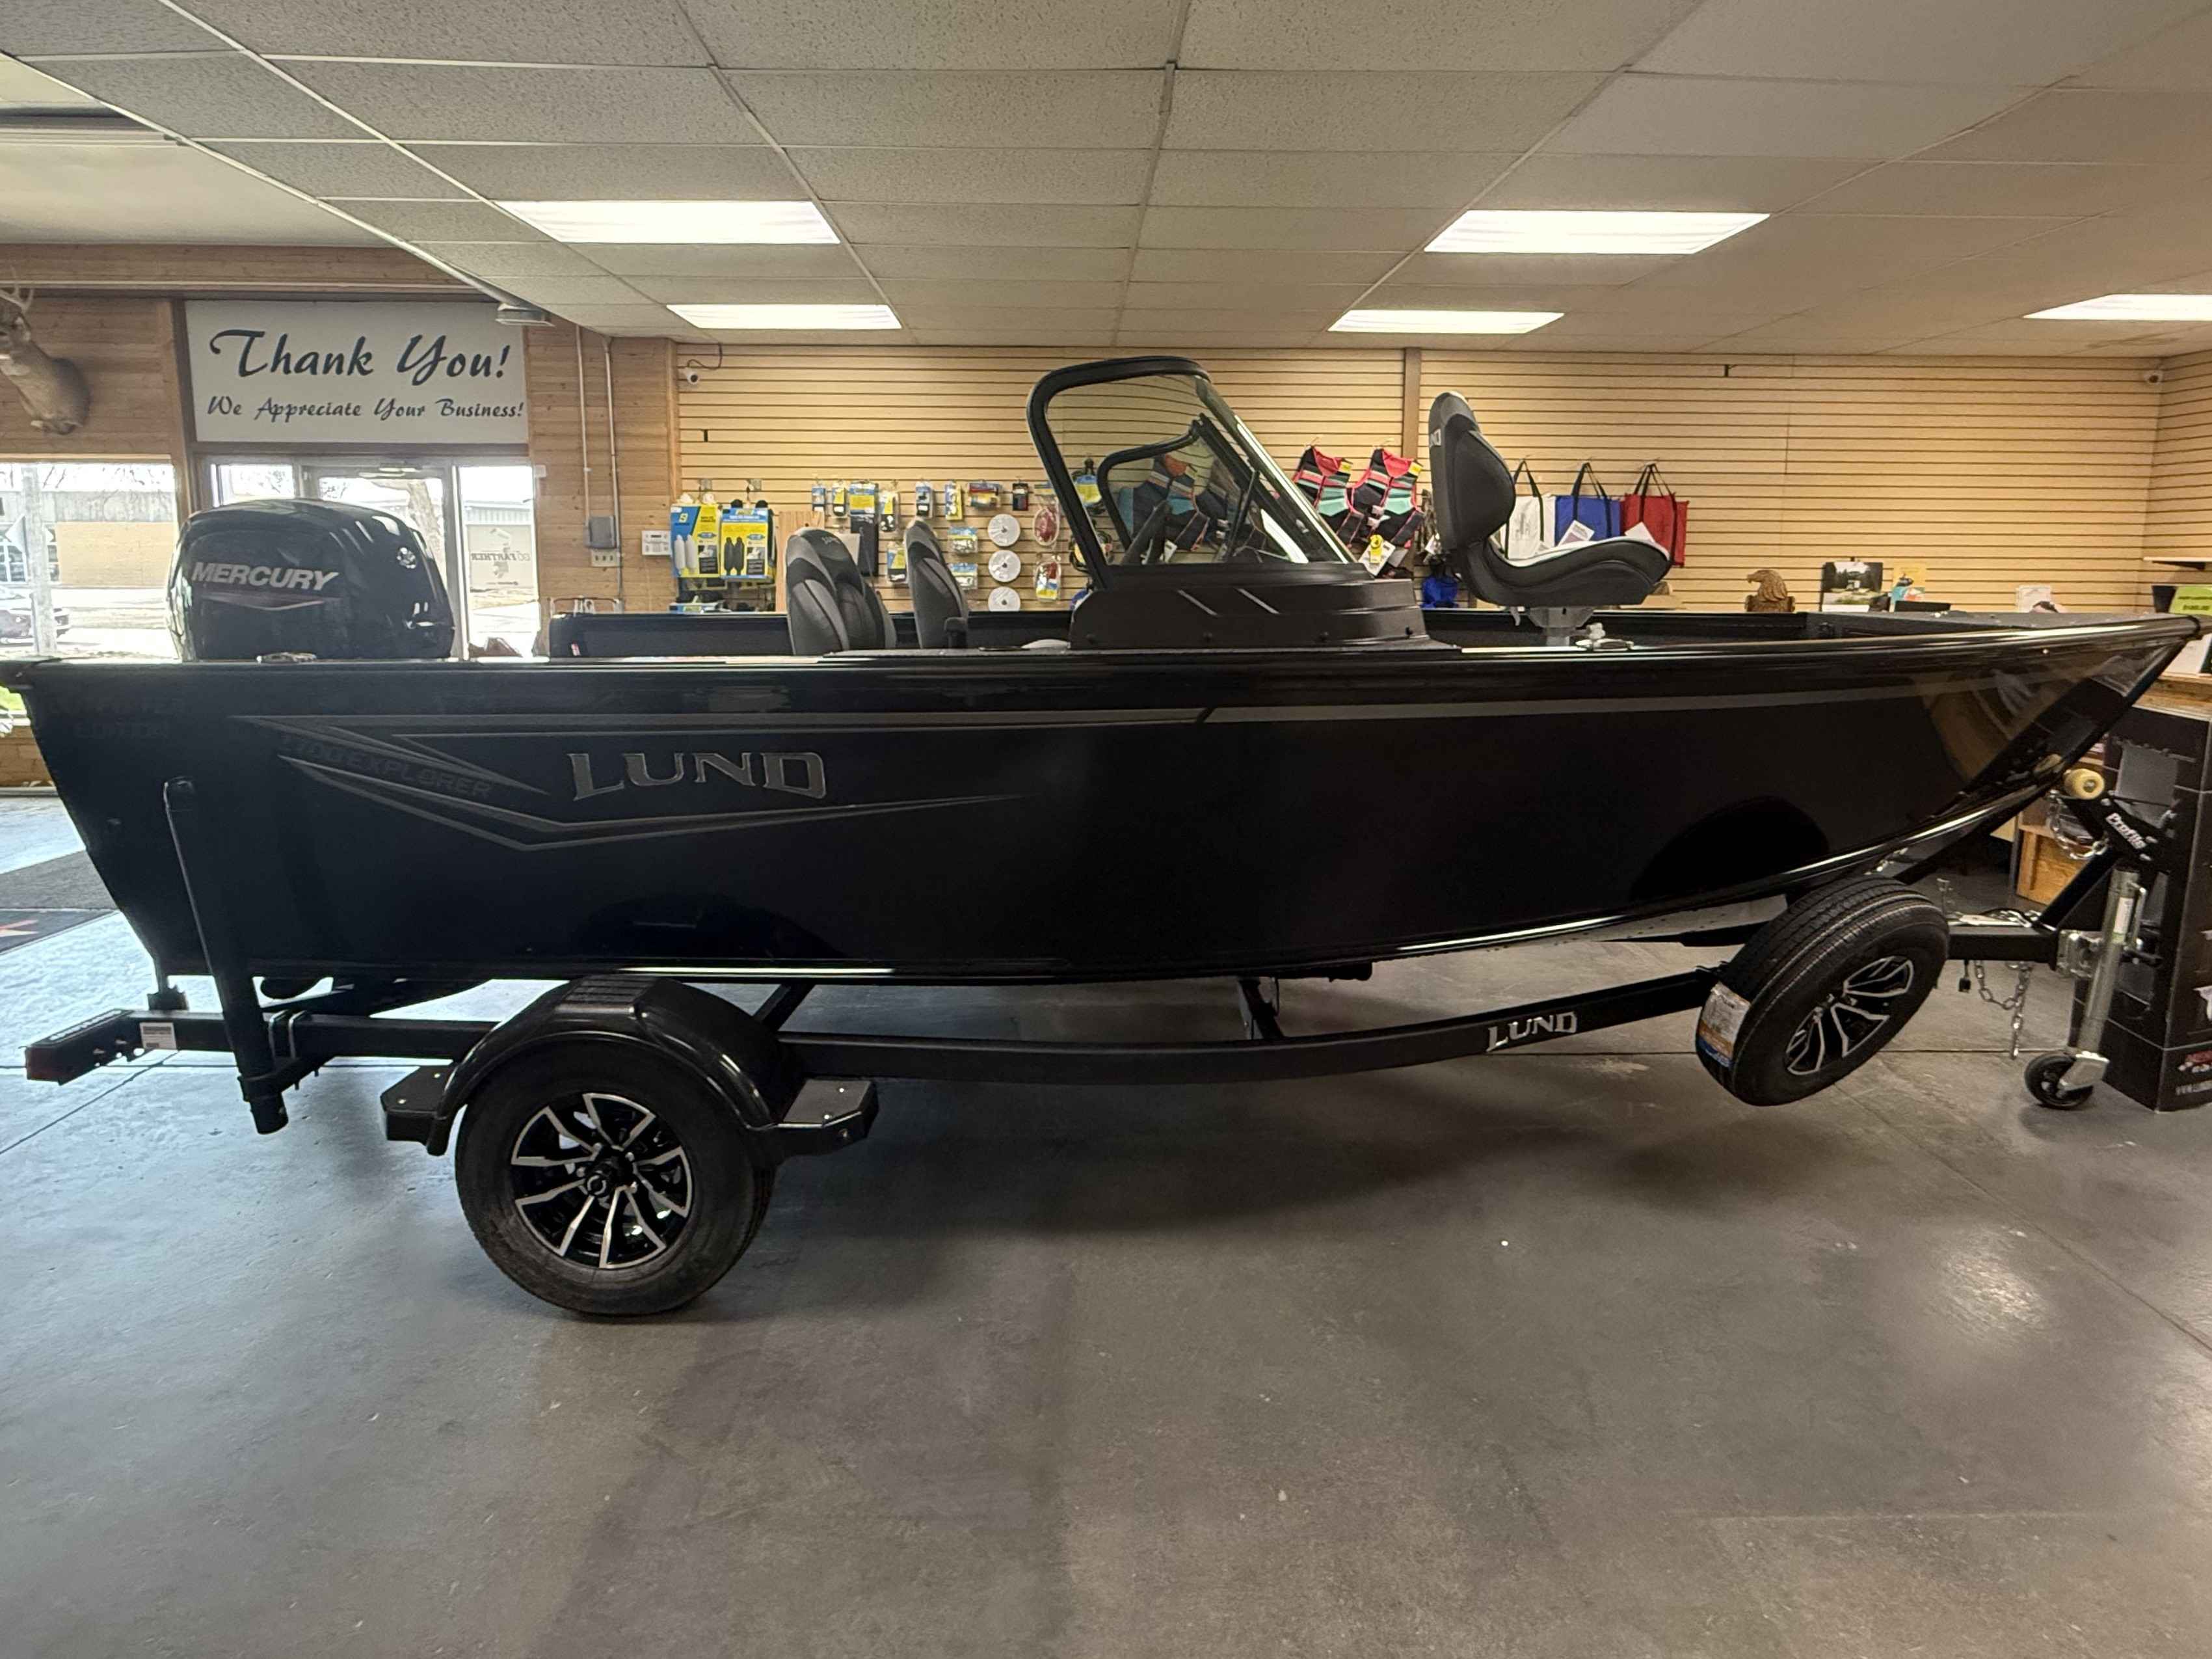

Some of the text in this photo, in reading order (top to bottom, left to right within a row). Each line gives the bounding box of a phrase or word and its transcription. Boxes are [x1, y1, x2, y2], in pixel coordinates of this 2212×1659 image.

[209, 329, 511, 386] Thank You!
[207, 396, 524, 423] We Appreciate Your Business!
[192, 561, 340, 591] MERCURY
[566, 752, 827, 802] LUND
[1486, 1010, 1578, 1053] LUND
